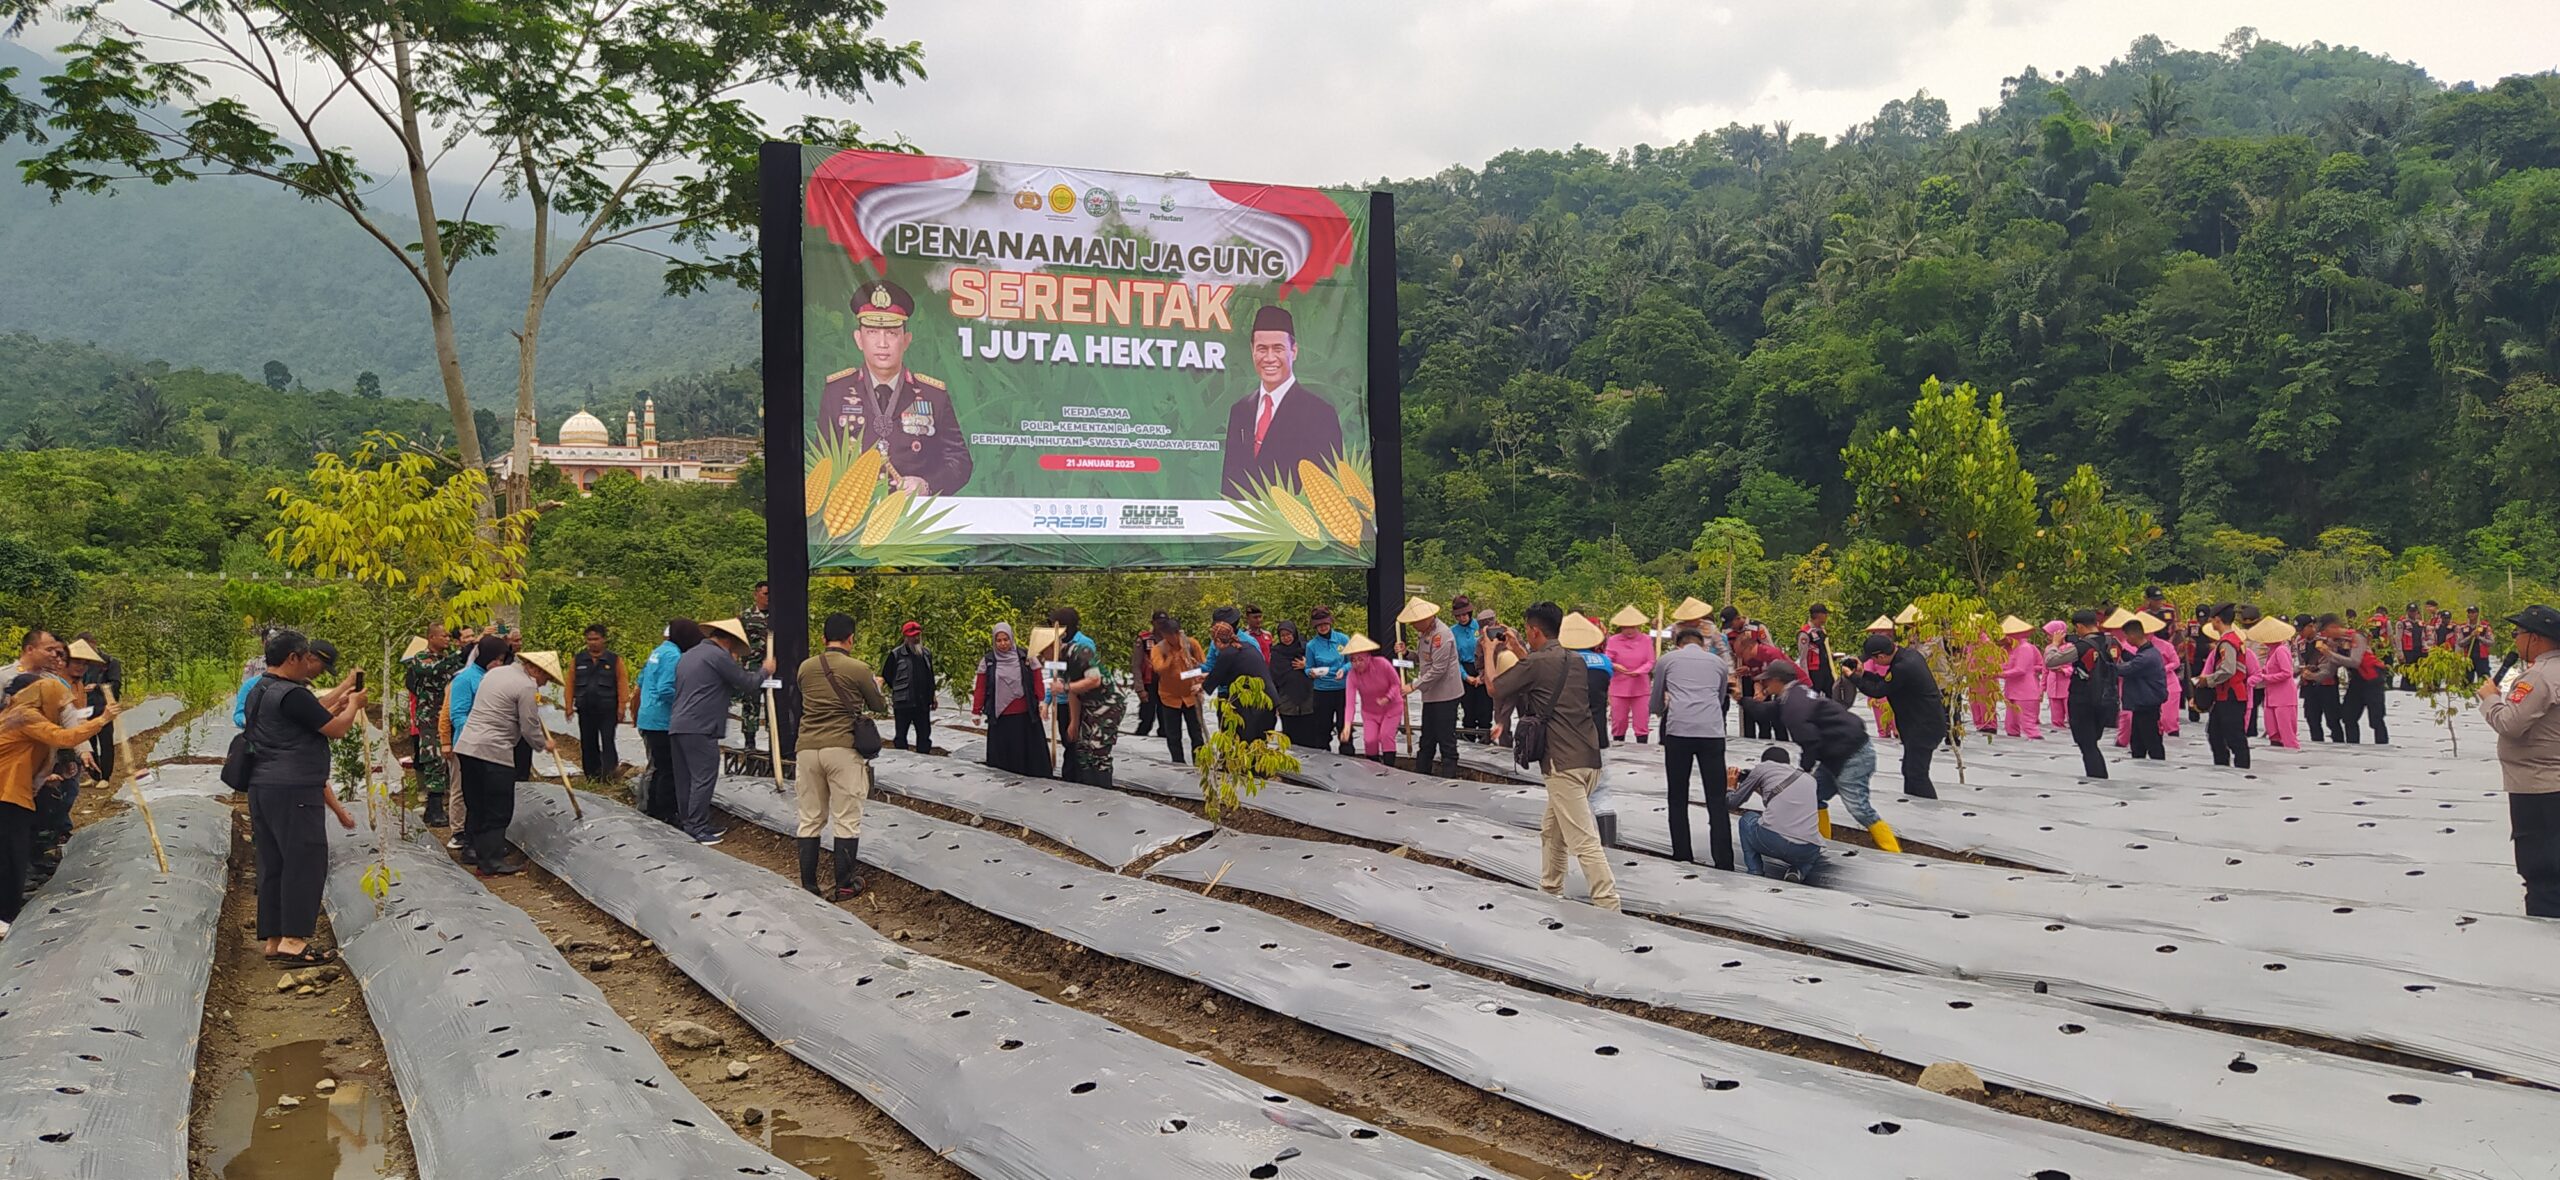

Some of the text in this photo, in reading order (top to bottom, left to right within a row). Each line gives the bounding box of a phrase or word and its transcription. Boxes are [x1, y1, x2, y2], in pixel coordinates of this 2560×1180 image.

[1149, 212, 1184, 222] Perhutani
[897, 224, 1286, 277] PENANAMAN JAGUNG
[950, 268, 1234, 332] SERENTAK
[958, 327, 1226, 370] 1 JUTA HEKTAR
[1062, 406, 1130, 419] KERJA SAMA
[1022, 420, 1053, 431] POLRI
[1059, 422, 1115, 433] KEMENTAN
[1116, 424, 1129, 434] R.I
[1135, 424, 1166, 435] GAPKI
[971, 434, 1034, 447] PERHUTANI,
[1034, 436, 1082, 446] INHUTANI
[1088, 437, 1131, 448] SWASTA
[1136, 439, 1184, 450] SWADAYA
[1185, 440, 1220, 451] PETANI
[1066, 458, 1136, 469] 21 JANUARI 2025
[1033, 503, 1105, 516] POSKO
[1122, 505, 1179, 518] GUGUS
[1033, 516, 1108, 529] PRESISI
[1119, 517, 1184, 526] TUGAS POLRI
